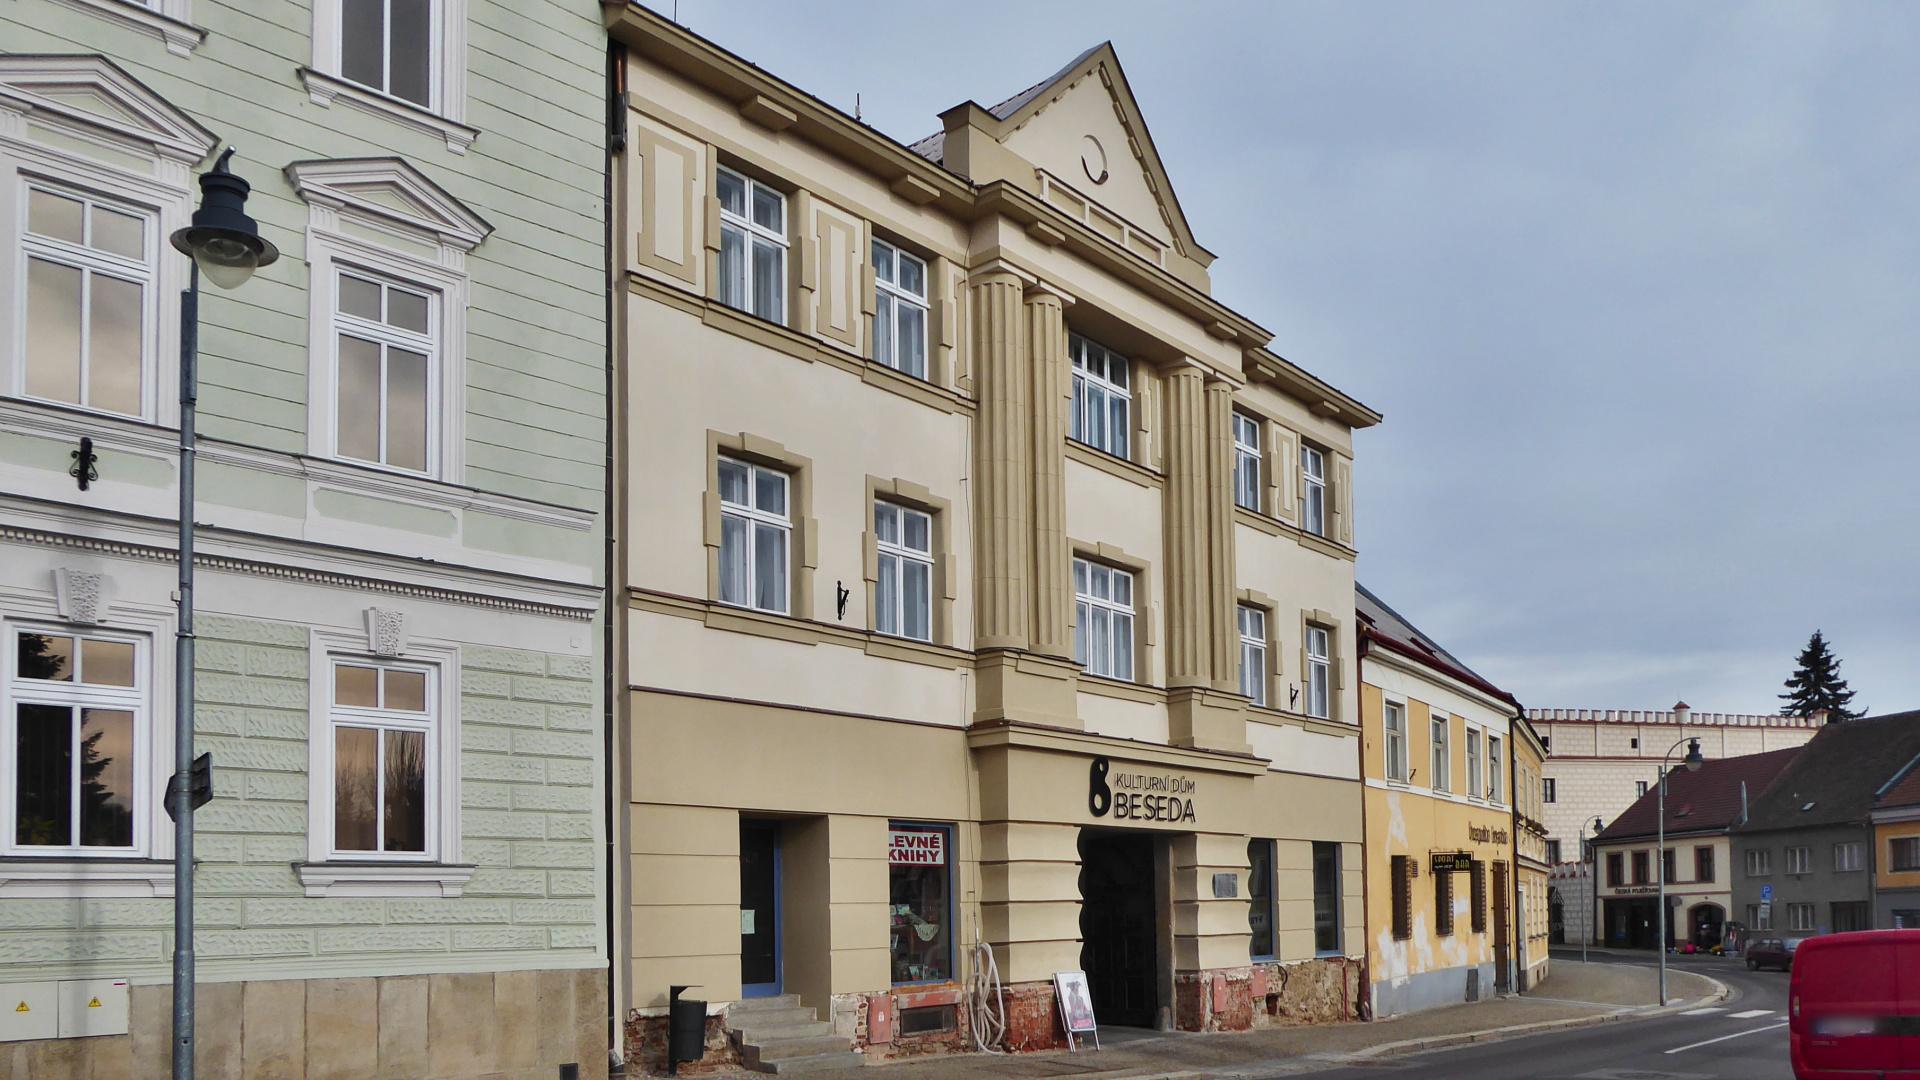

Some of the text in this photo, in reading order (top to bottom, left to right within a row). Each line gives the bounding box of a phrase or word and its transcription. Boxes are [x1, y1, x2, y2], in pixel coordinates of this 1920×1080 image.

[1115, 773, 1196, 794] KULTURNÍ DŮM
[1114, 793, 1196, 823] BESEDA
